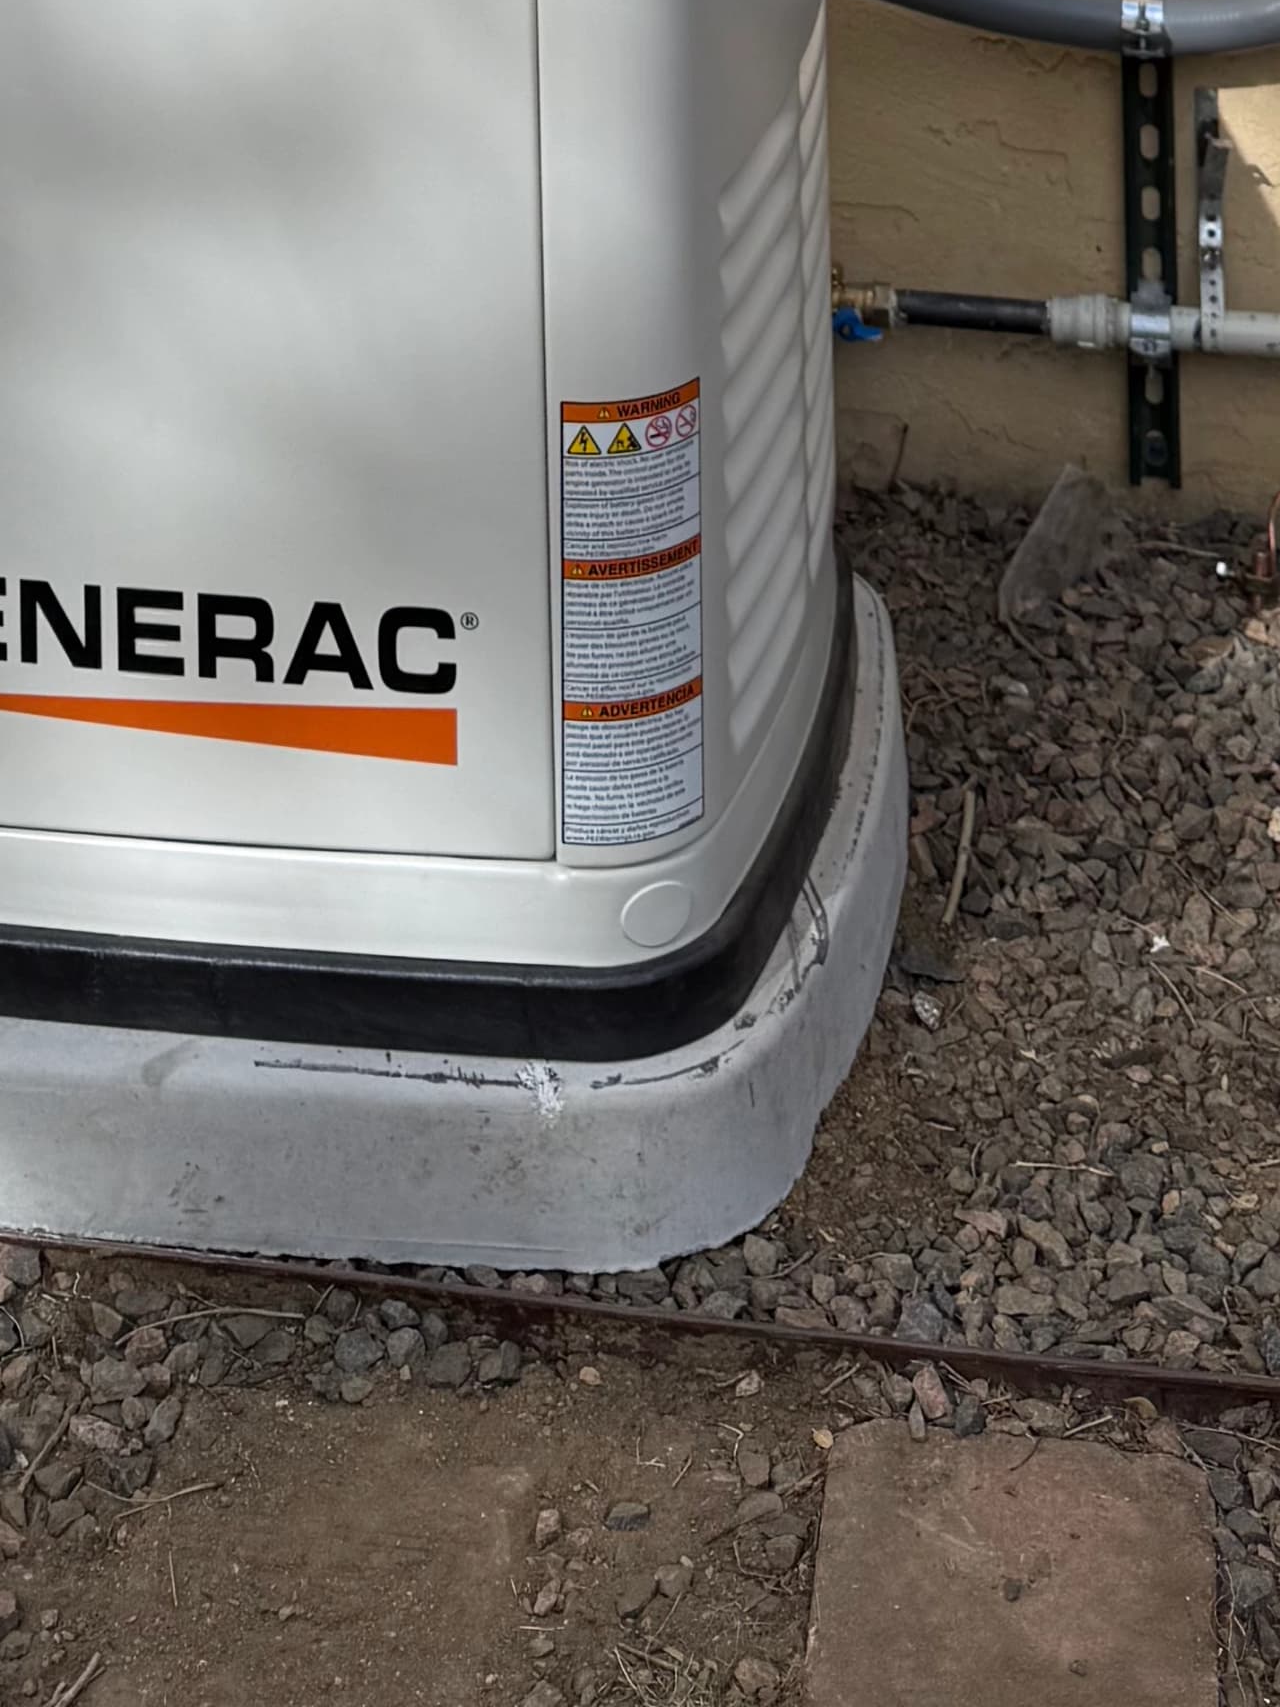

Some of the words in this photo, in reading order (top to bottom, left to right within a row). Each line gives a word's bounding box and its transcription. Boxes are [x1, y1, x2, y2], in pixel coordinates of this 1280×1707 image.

[617, 392, 680, 418] WARNING
[588, 540, 697, 576] AVERTISSEMENT
[599, 686, 694, 718] ADVERTENCIA
